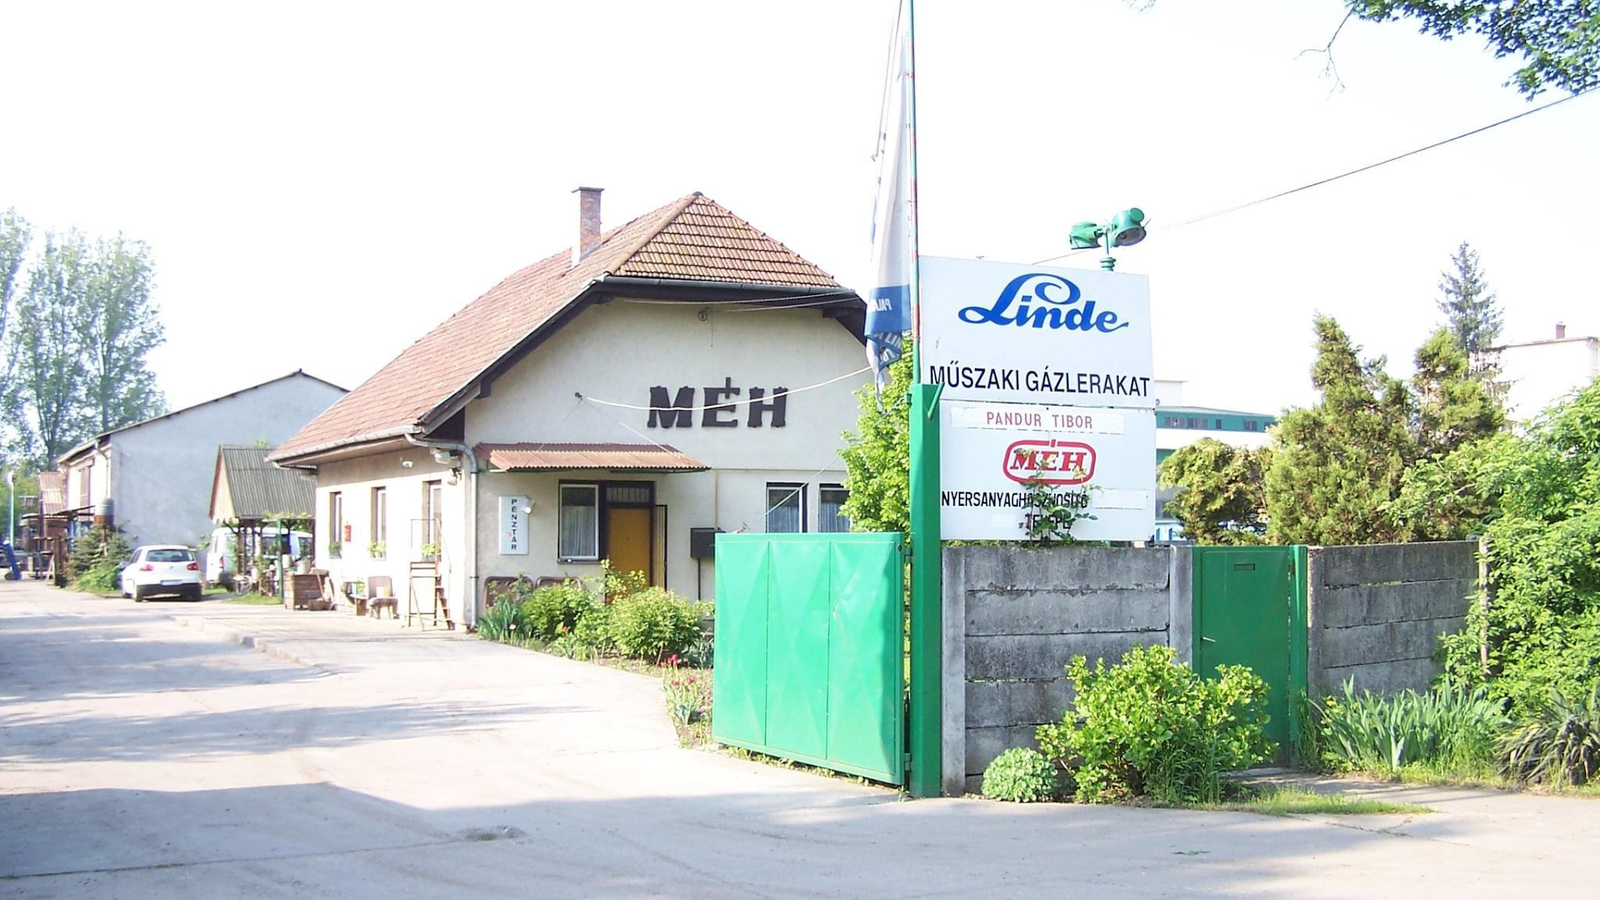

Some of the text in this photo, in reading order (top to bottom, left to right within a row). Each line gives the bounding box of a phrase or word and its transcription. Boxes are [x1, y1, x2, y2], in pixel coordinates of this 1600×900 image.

[958, 273, 1129, 333] Linde
[930, 361, 1151, 397] MŰSZAKI GÁZLERAKAT
[647, 377, 789, 428] MÉH
[986, 411, 1093, 430] PANDUR TIBOR
